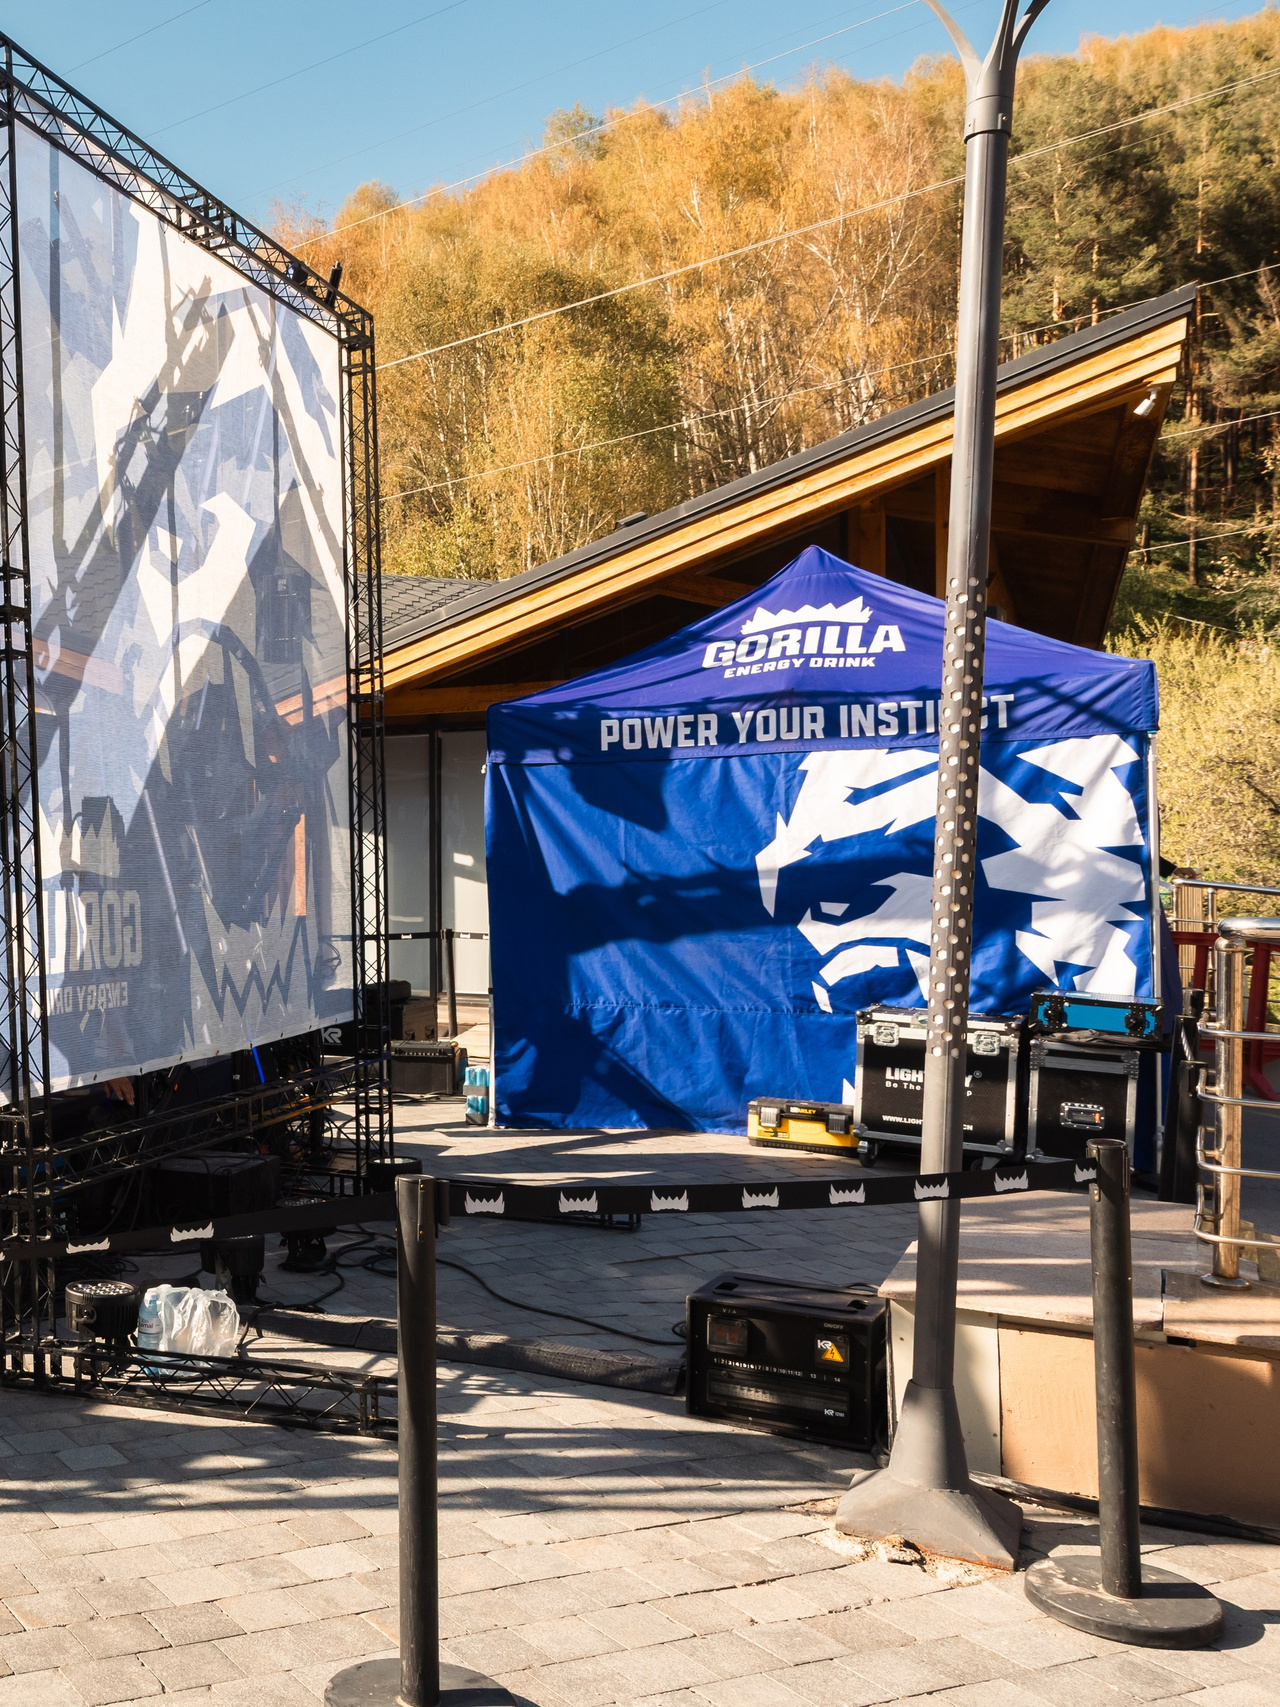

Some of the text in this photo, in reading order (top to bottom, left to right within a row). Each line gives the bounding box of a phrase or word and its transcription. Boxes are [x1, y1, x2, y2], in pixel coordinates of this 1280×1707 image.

[702, 624, 907, 669] GORILLA
[723, 656, 876, 679] ENERGY DRINK
[600, 694, 1015, 751] POWER YOUR INSTIT
[321, 1028, 342, 1044] KR
[885, 1067, 973, 1088] LIGHY
[903, 1082, 922, 1091] The
[817, 1339, 832, 1350] KR
